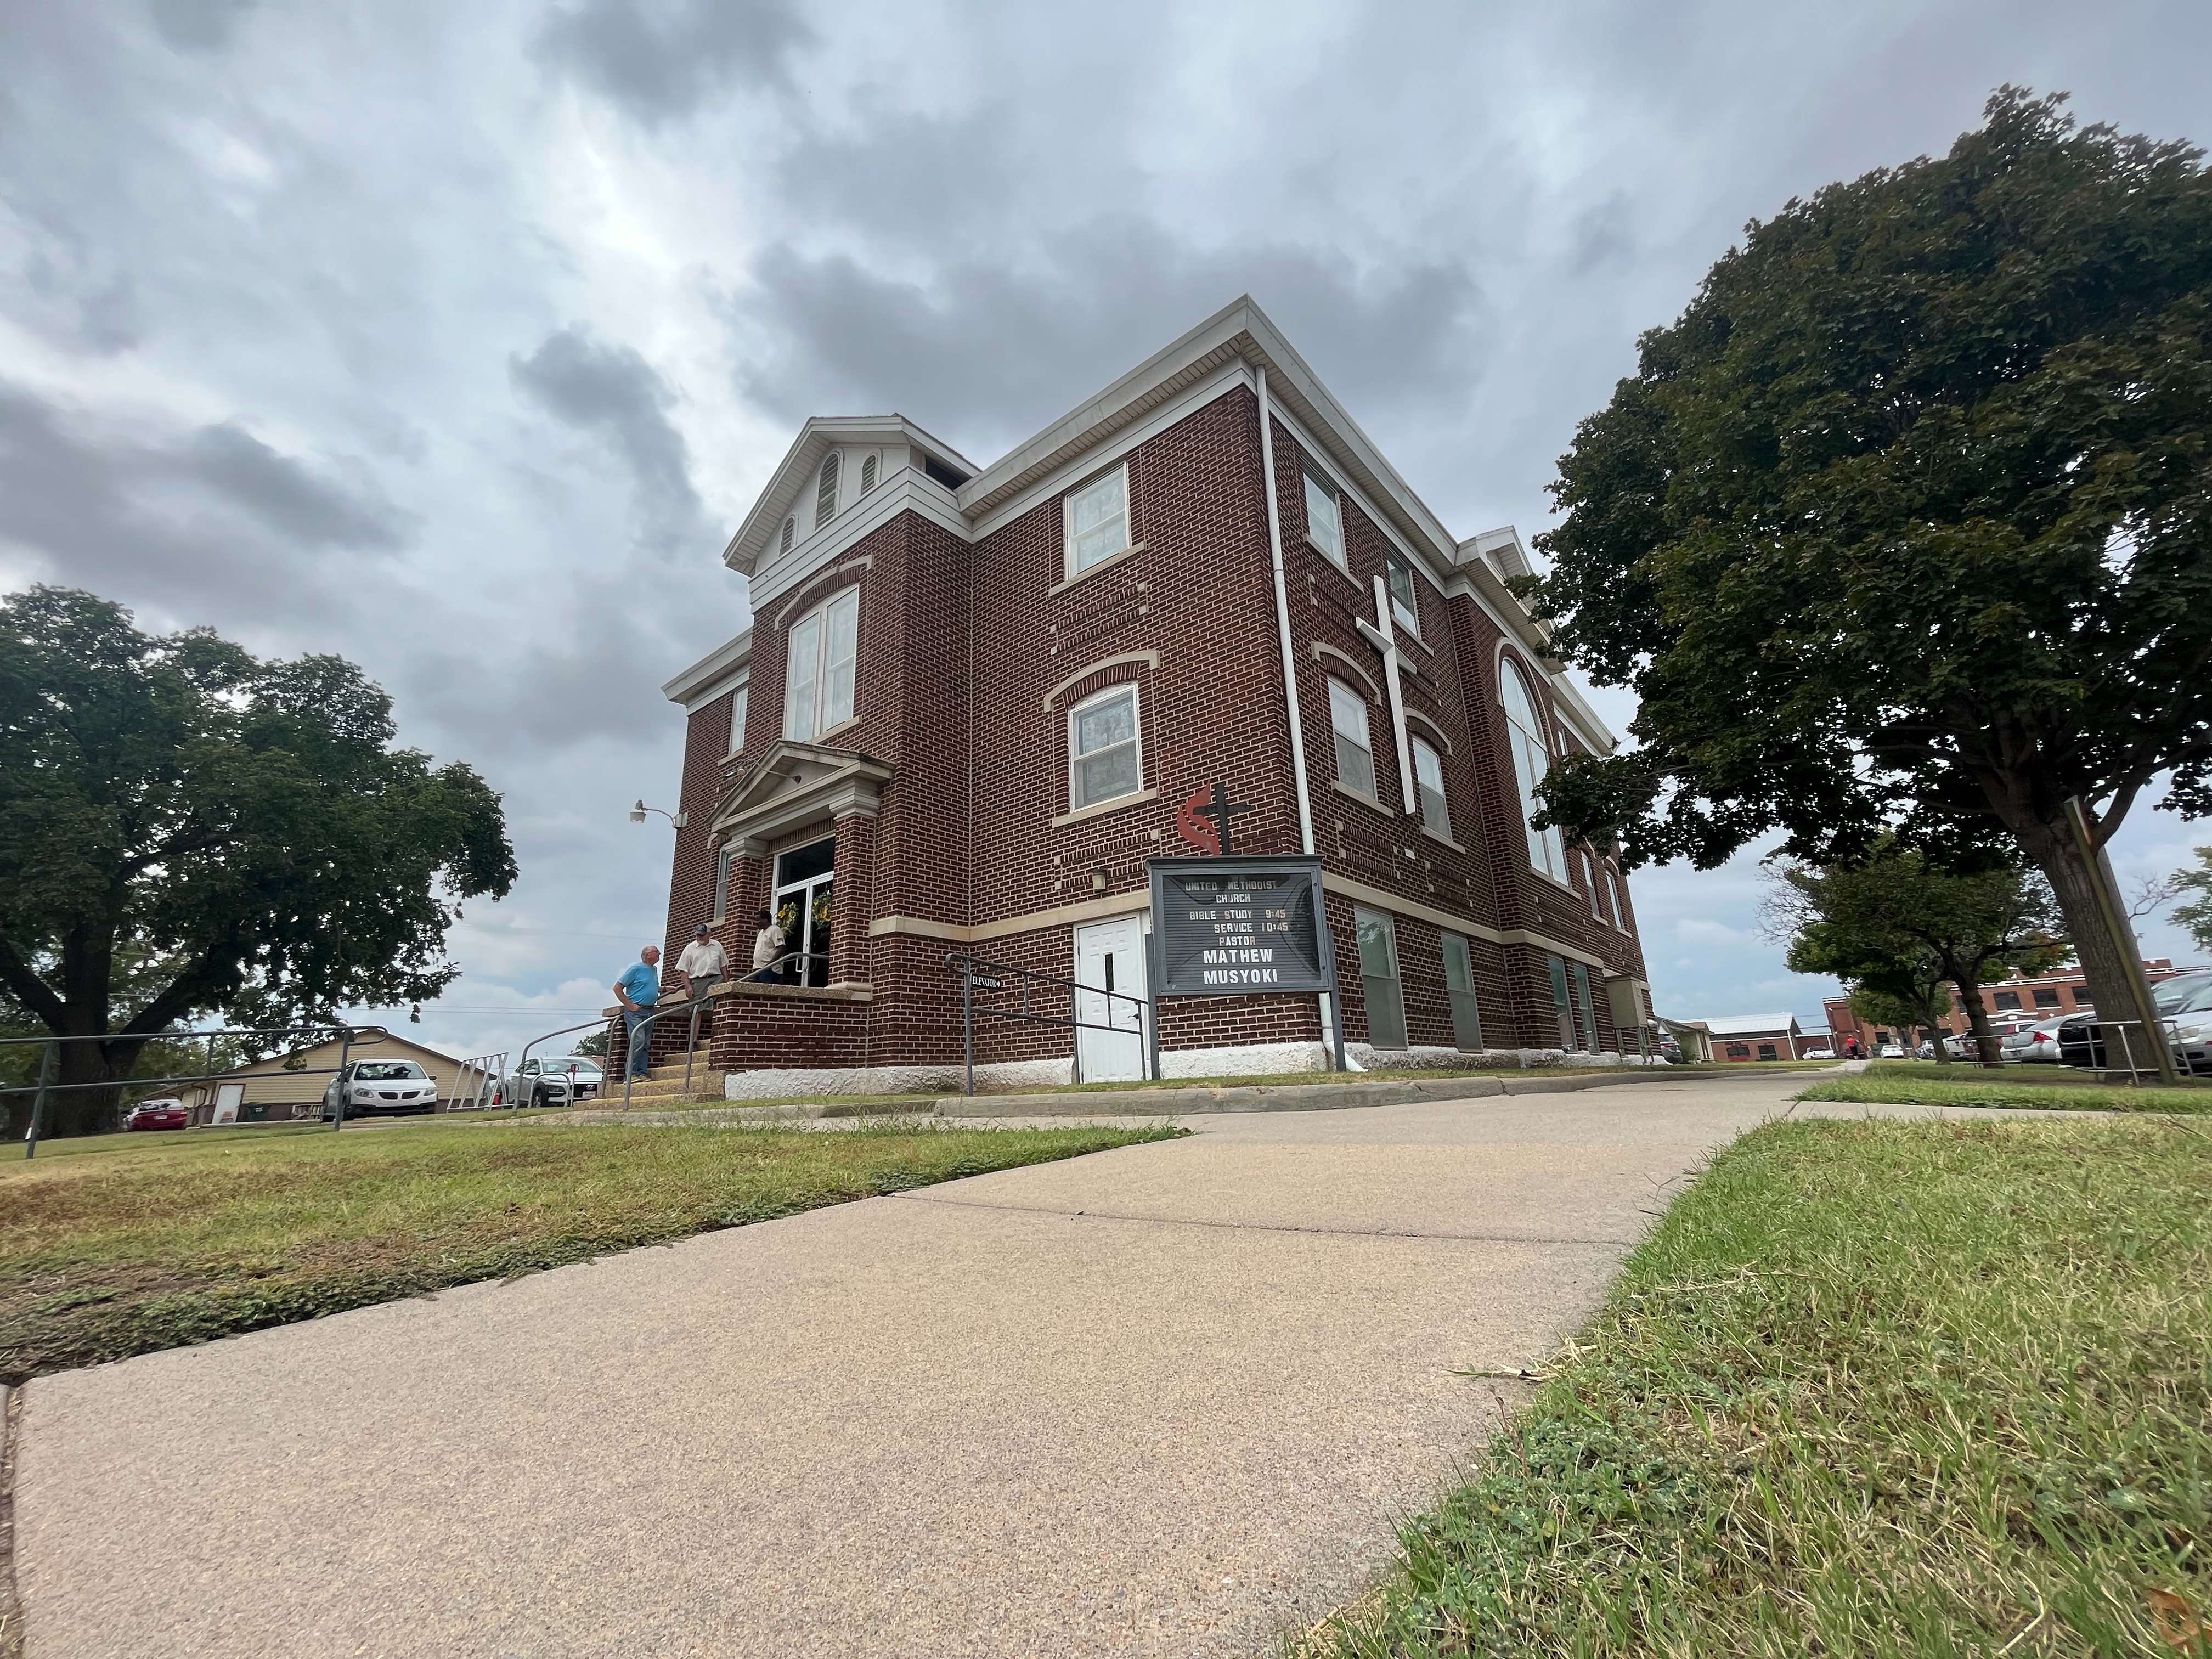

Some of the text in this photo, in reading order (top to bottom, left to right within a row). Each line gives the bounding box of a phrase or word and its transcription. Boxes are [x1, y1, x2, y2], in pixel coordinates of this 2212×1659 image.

[1186, 881, 1277, 891] UNITED METHODIST
[1216, 894, 1251, 904] CHURCH
[1189, 909, 1286, 920] BIBLE STUDY 9:45
[1214, 922, 1289, 933] SERVICE 10:45
[1219, 936, 1256, 946] PASTOR
[1203, 949, 1273, 964] MATHEW
[1203, 968, 1278, 984] MUSYOKI
[972, 976, 996, 988] ELEVATOR
